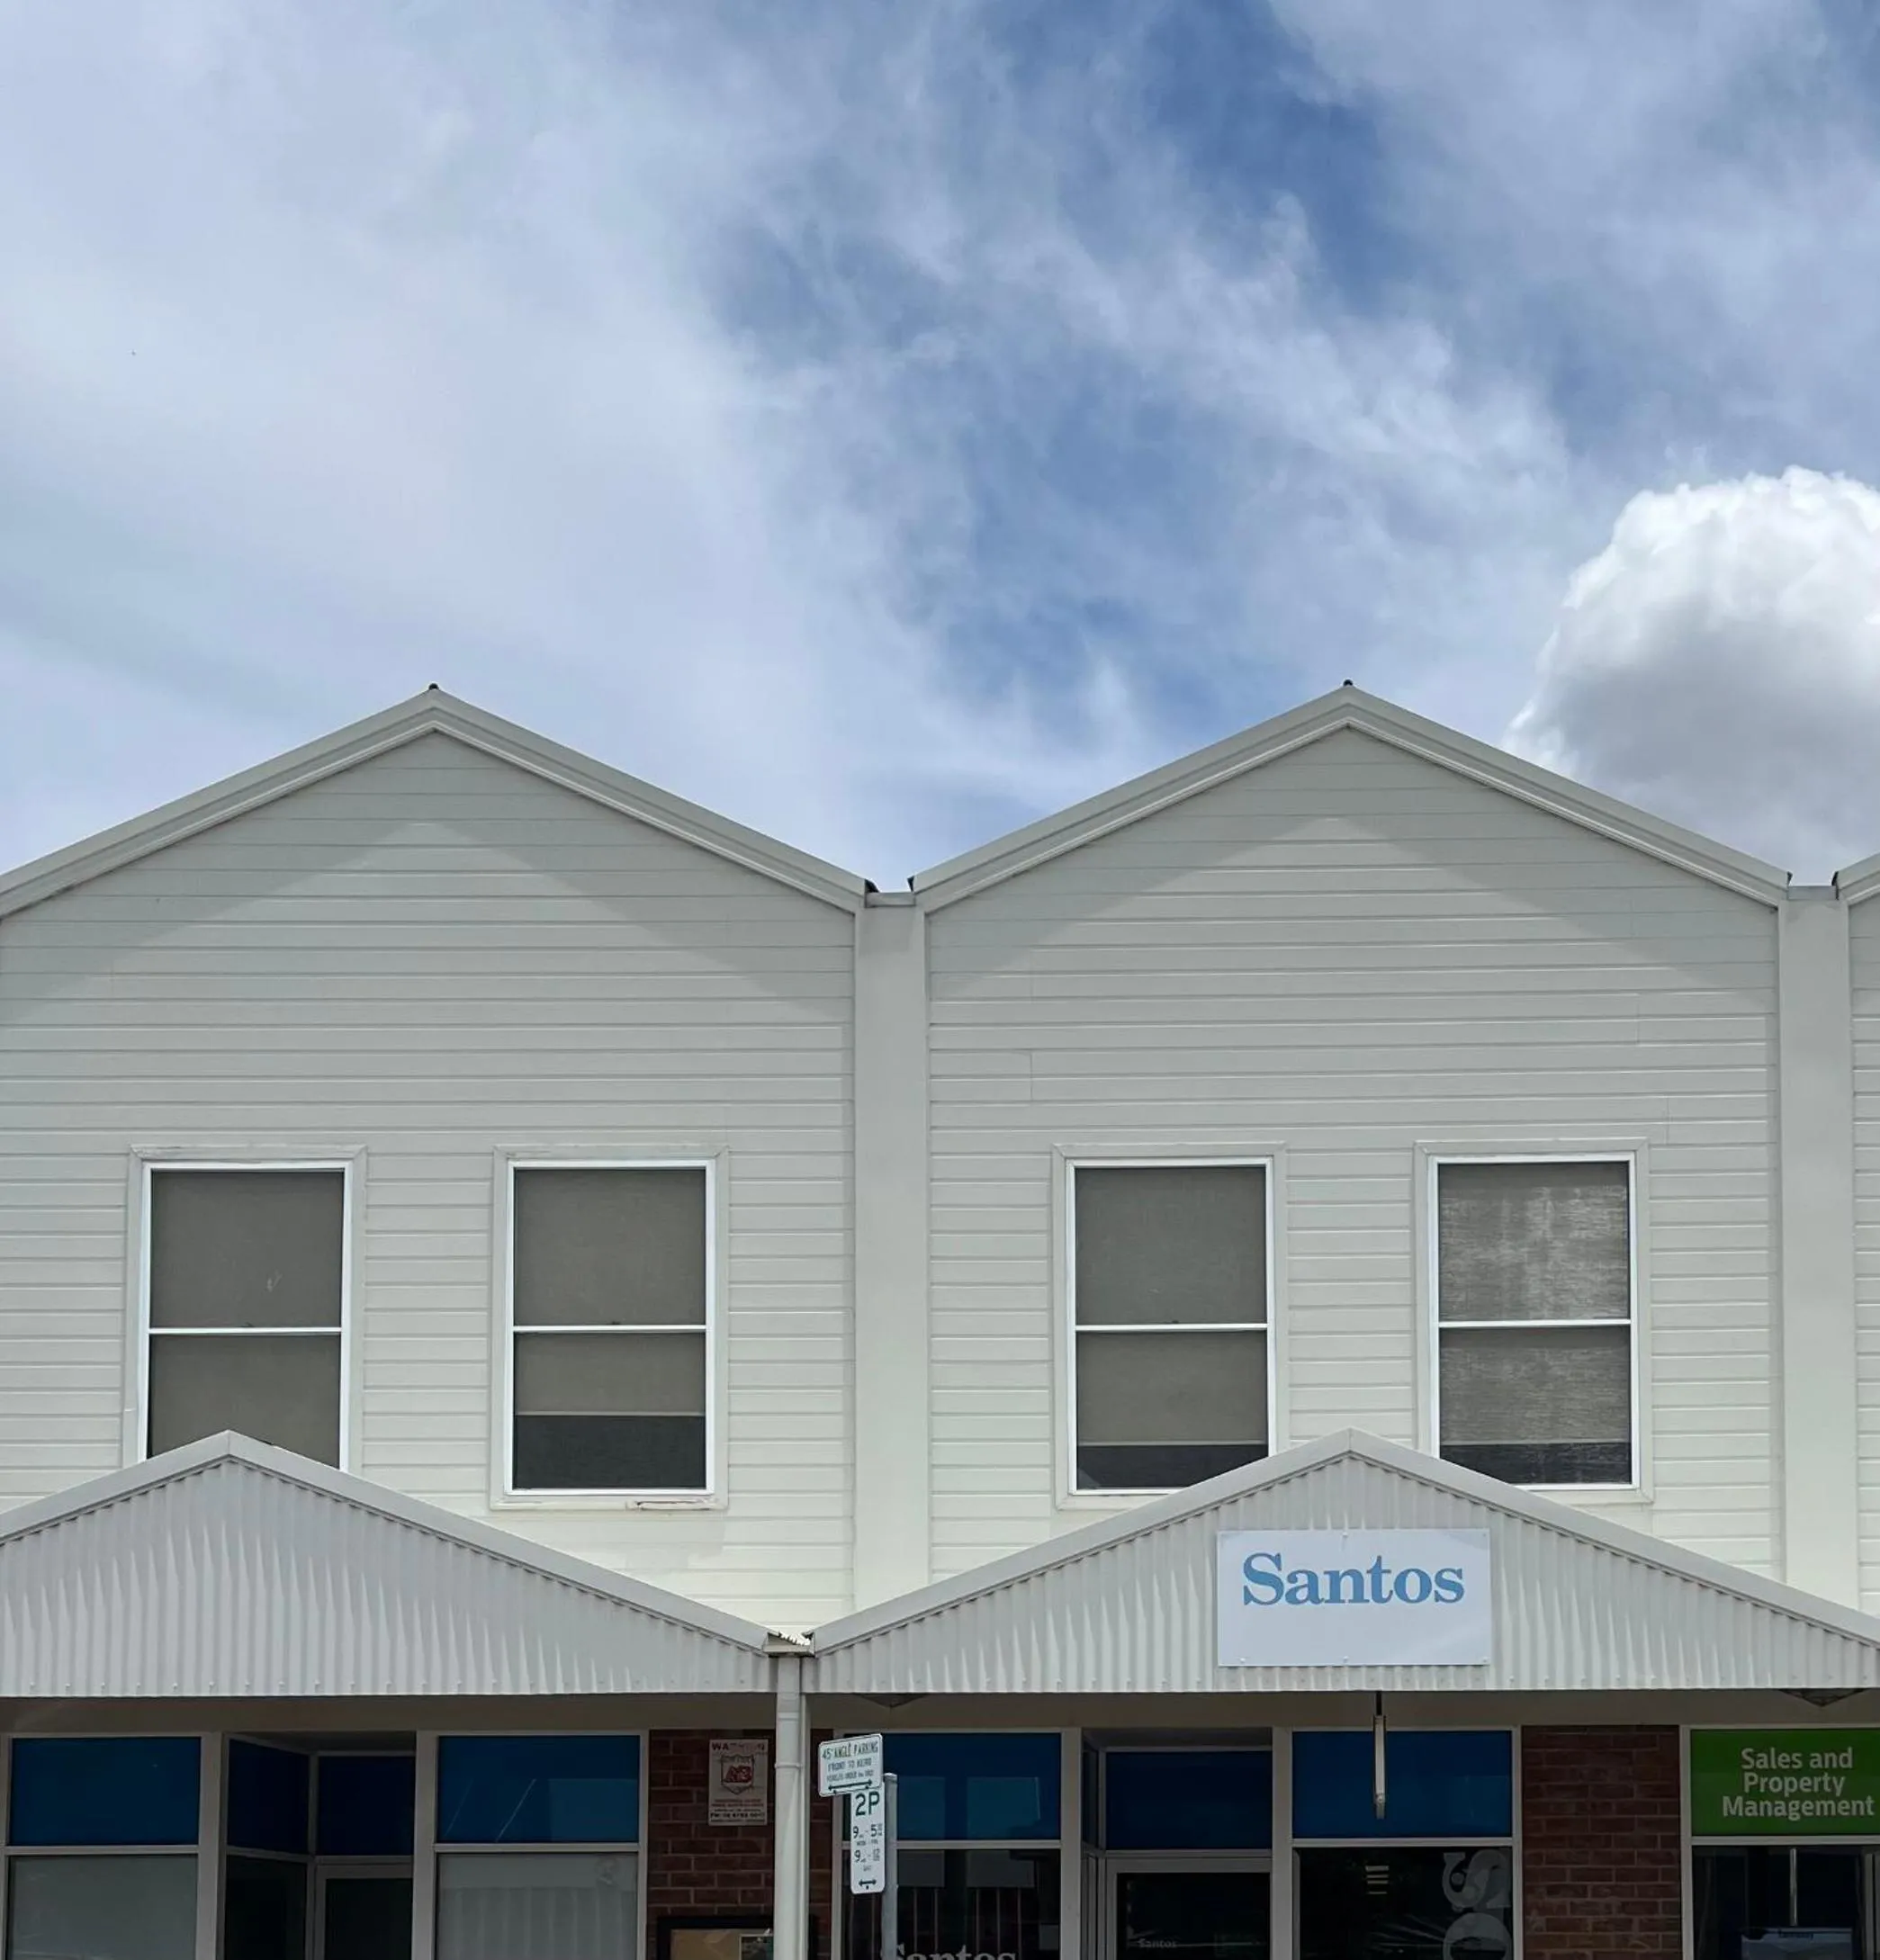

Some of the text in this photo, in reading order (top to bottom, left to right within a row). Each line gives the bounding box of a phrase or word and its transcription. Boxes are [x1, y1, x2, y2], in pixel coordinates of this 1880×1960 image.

[1243, 1552, 1465, 1605] Santos
[853, 1740, 878, 1757] PARKING
[1741, 1746, 1853, 1769] Sales and
[1744, 1771, 1846, 1798] Property
[855, 1791, 880, 1816] 2P
[1723, 1795, 1876, 1821] Management
